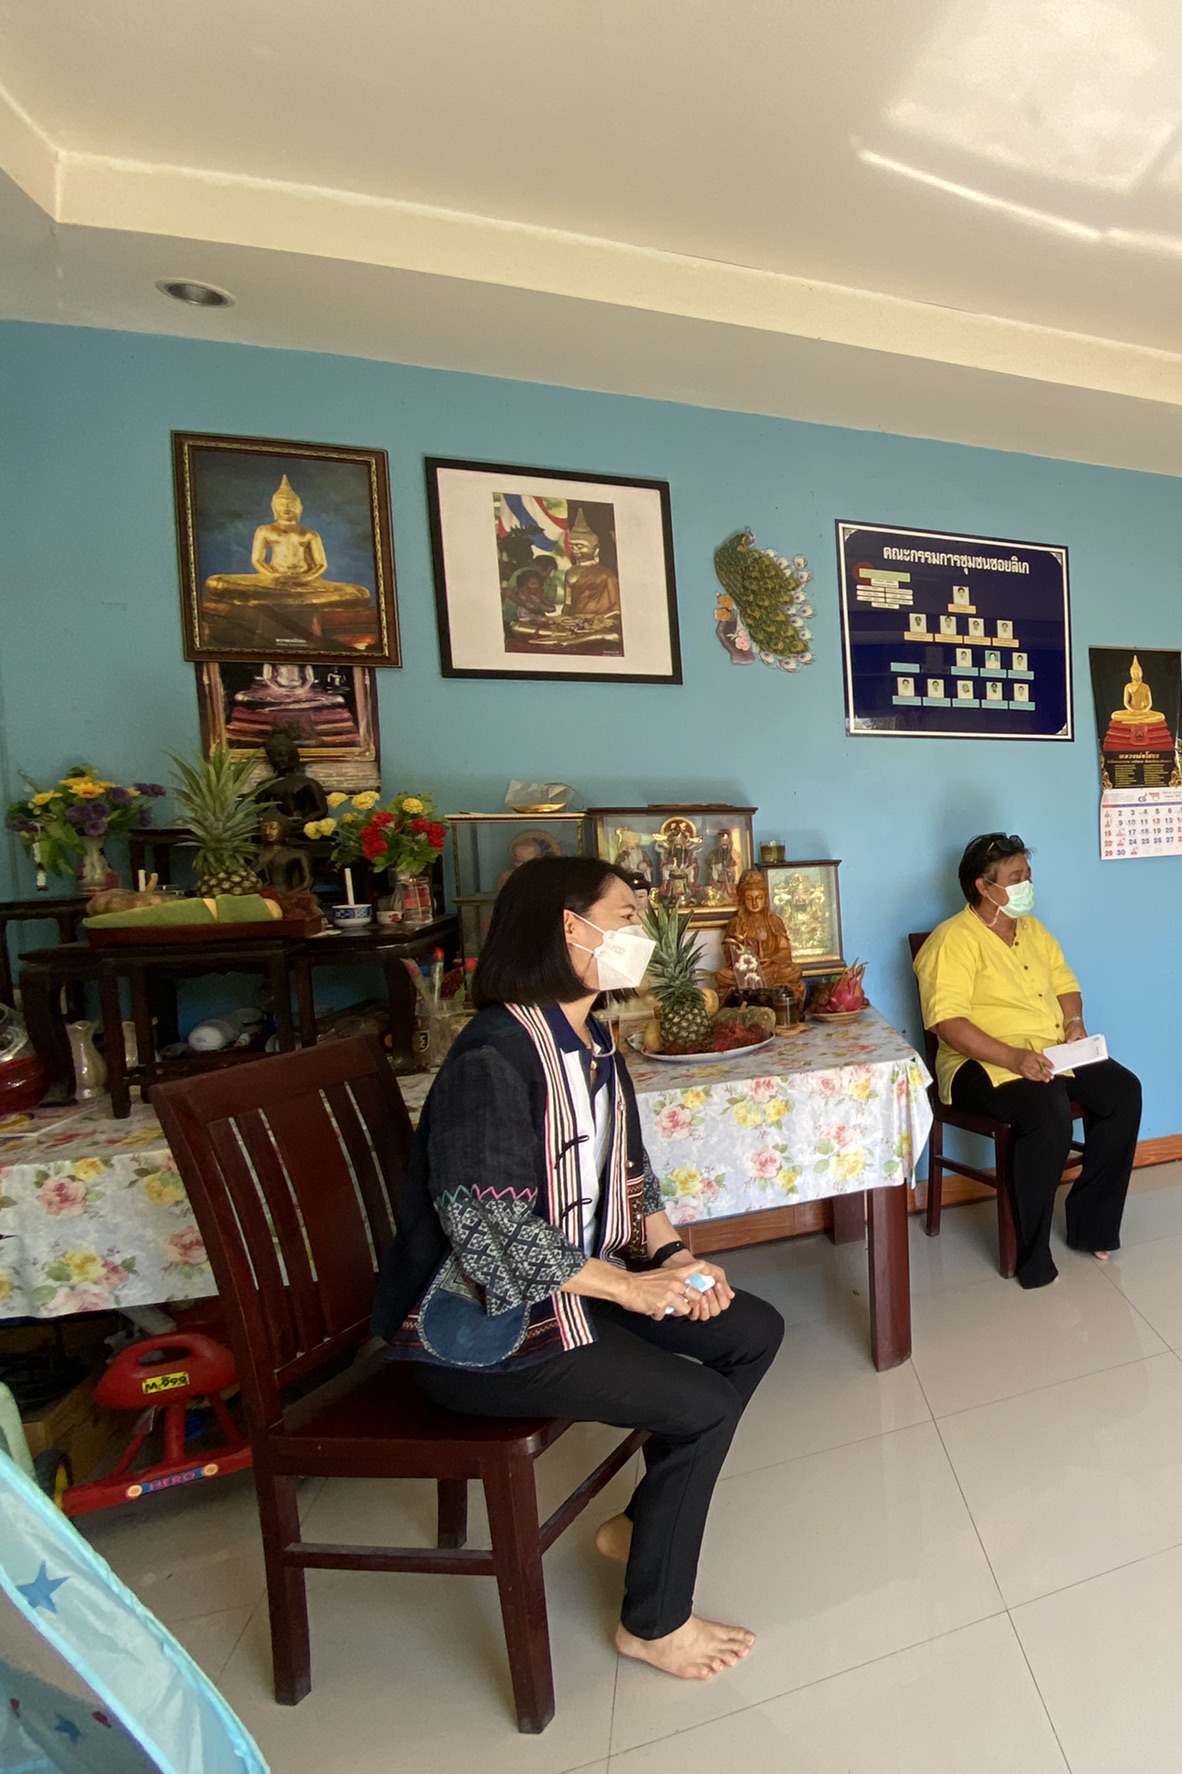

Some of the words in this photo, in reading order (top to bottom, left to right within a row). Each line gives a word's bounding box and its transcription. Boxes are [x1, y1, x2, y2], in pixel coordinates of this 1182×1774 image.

[883, 546, 1030, 575] คณะกรรมการชุมชนซอยลิเก
